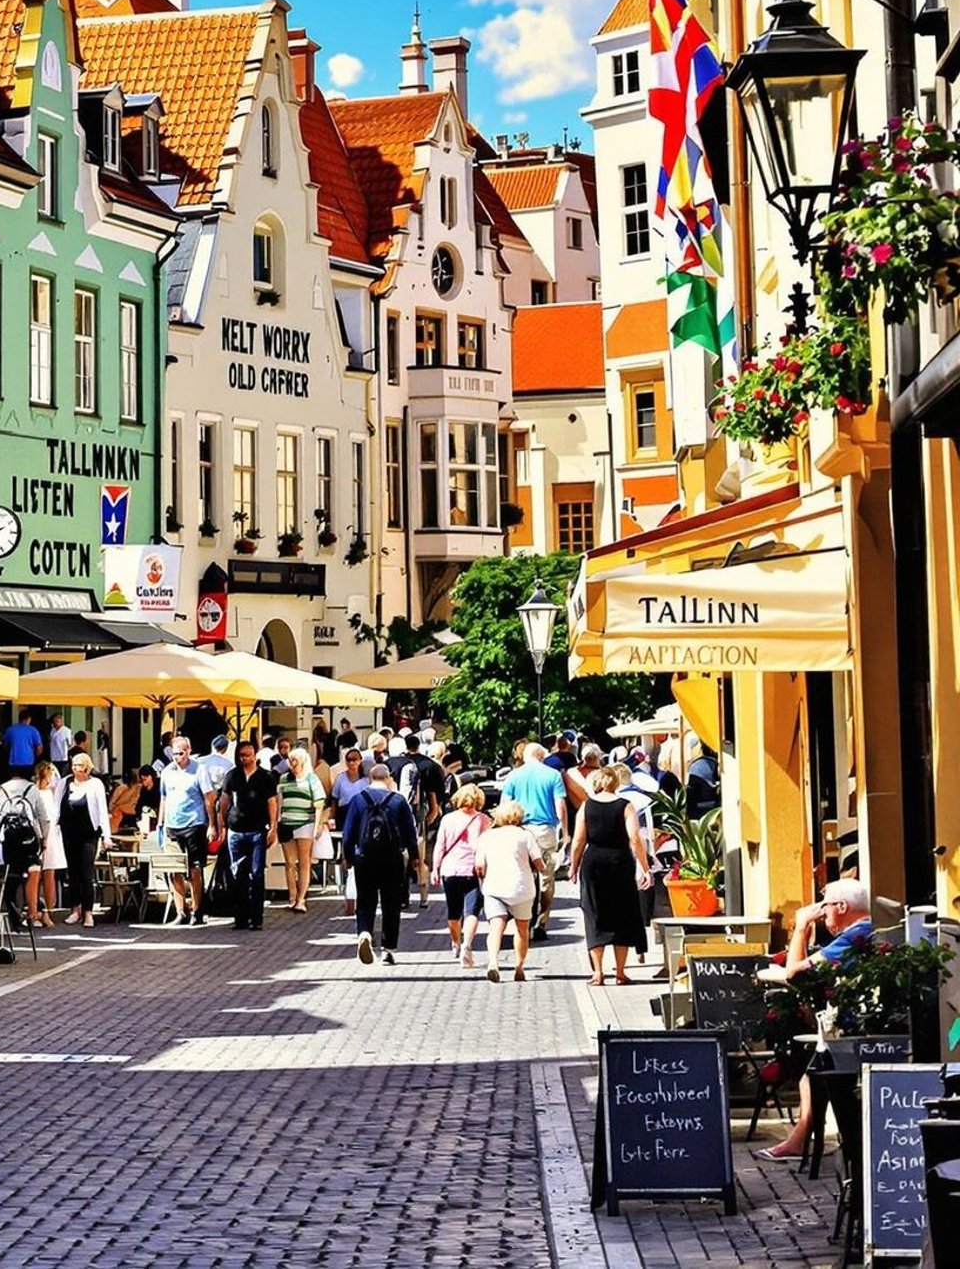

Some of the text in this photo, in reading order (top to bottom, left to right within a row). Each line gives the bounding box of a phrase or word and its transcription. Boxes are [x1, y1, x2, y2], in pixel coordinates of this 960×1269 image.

[221, 317, 258, 355] KELT
[228, 362, 256, 391] OLD
[11, 476, 74, 517] LISTEN
